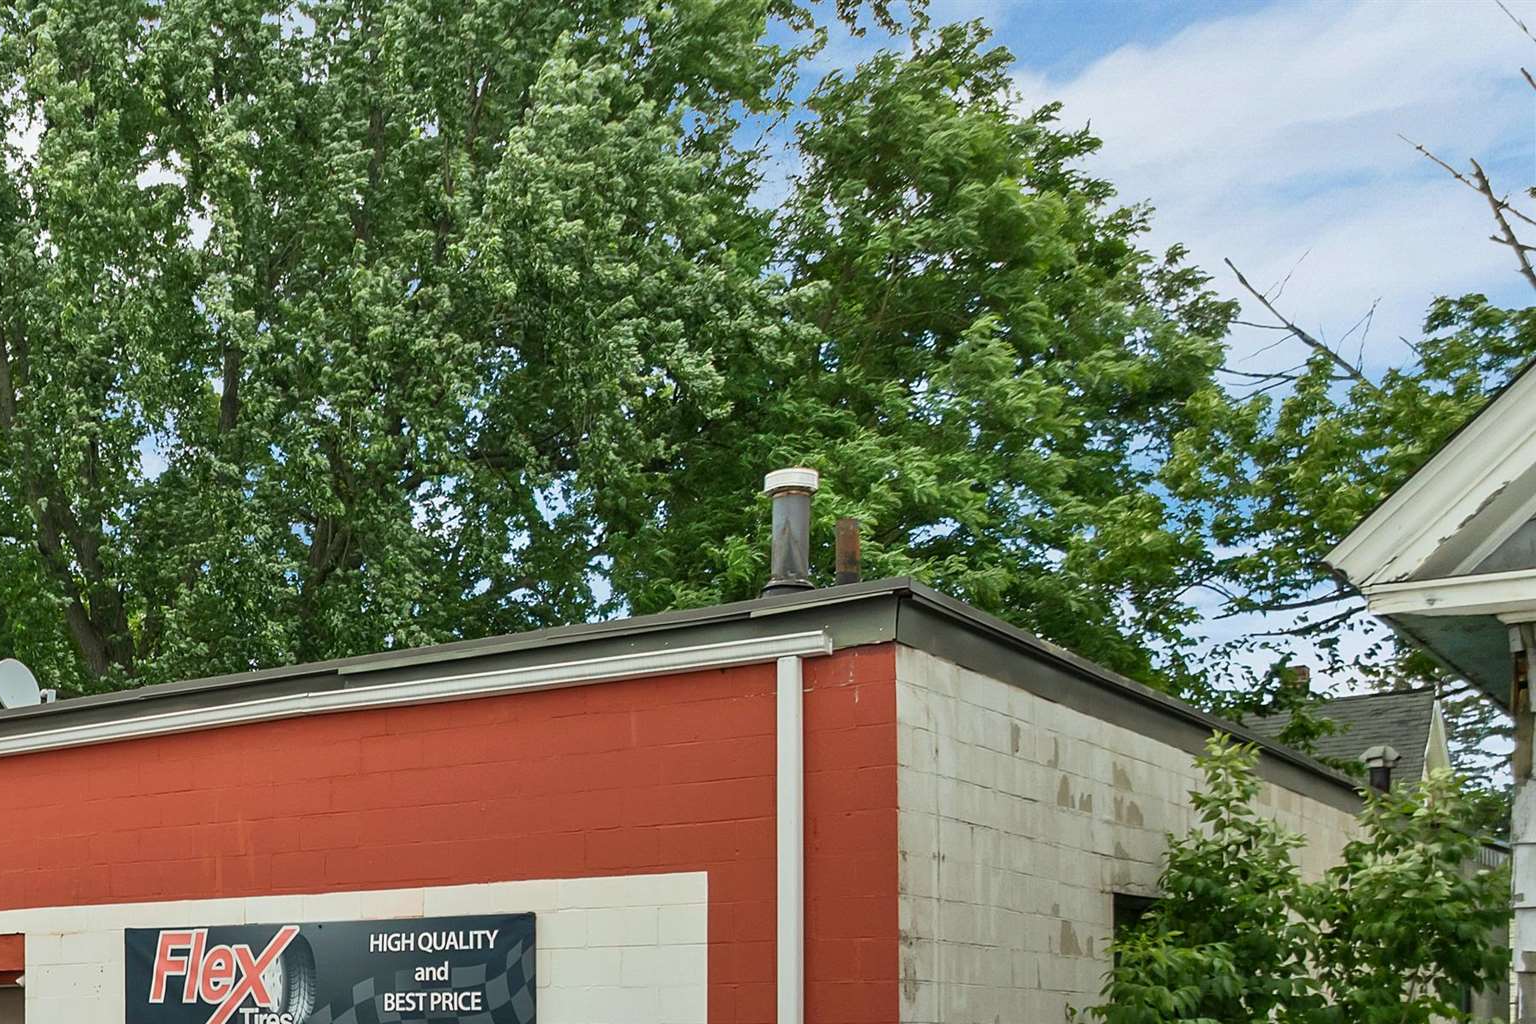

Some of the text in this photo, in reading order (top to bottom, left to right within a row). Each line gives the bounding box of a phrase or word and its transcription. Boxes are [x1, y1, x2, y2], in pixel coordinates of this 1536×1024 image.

[369, 929, 499, 953] HIGH QUALITY
[414, 961, 449, 981] and
[384, 992, 483, 1012] BEST PRICE
